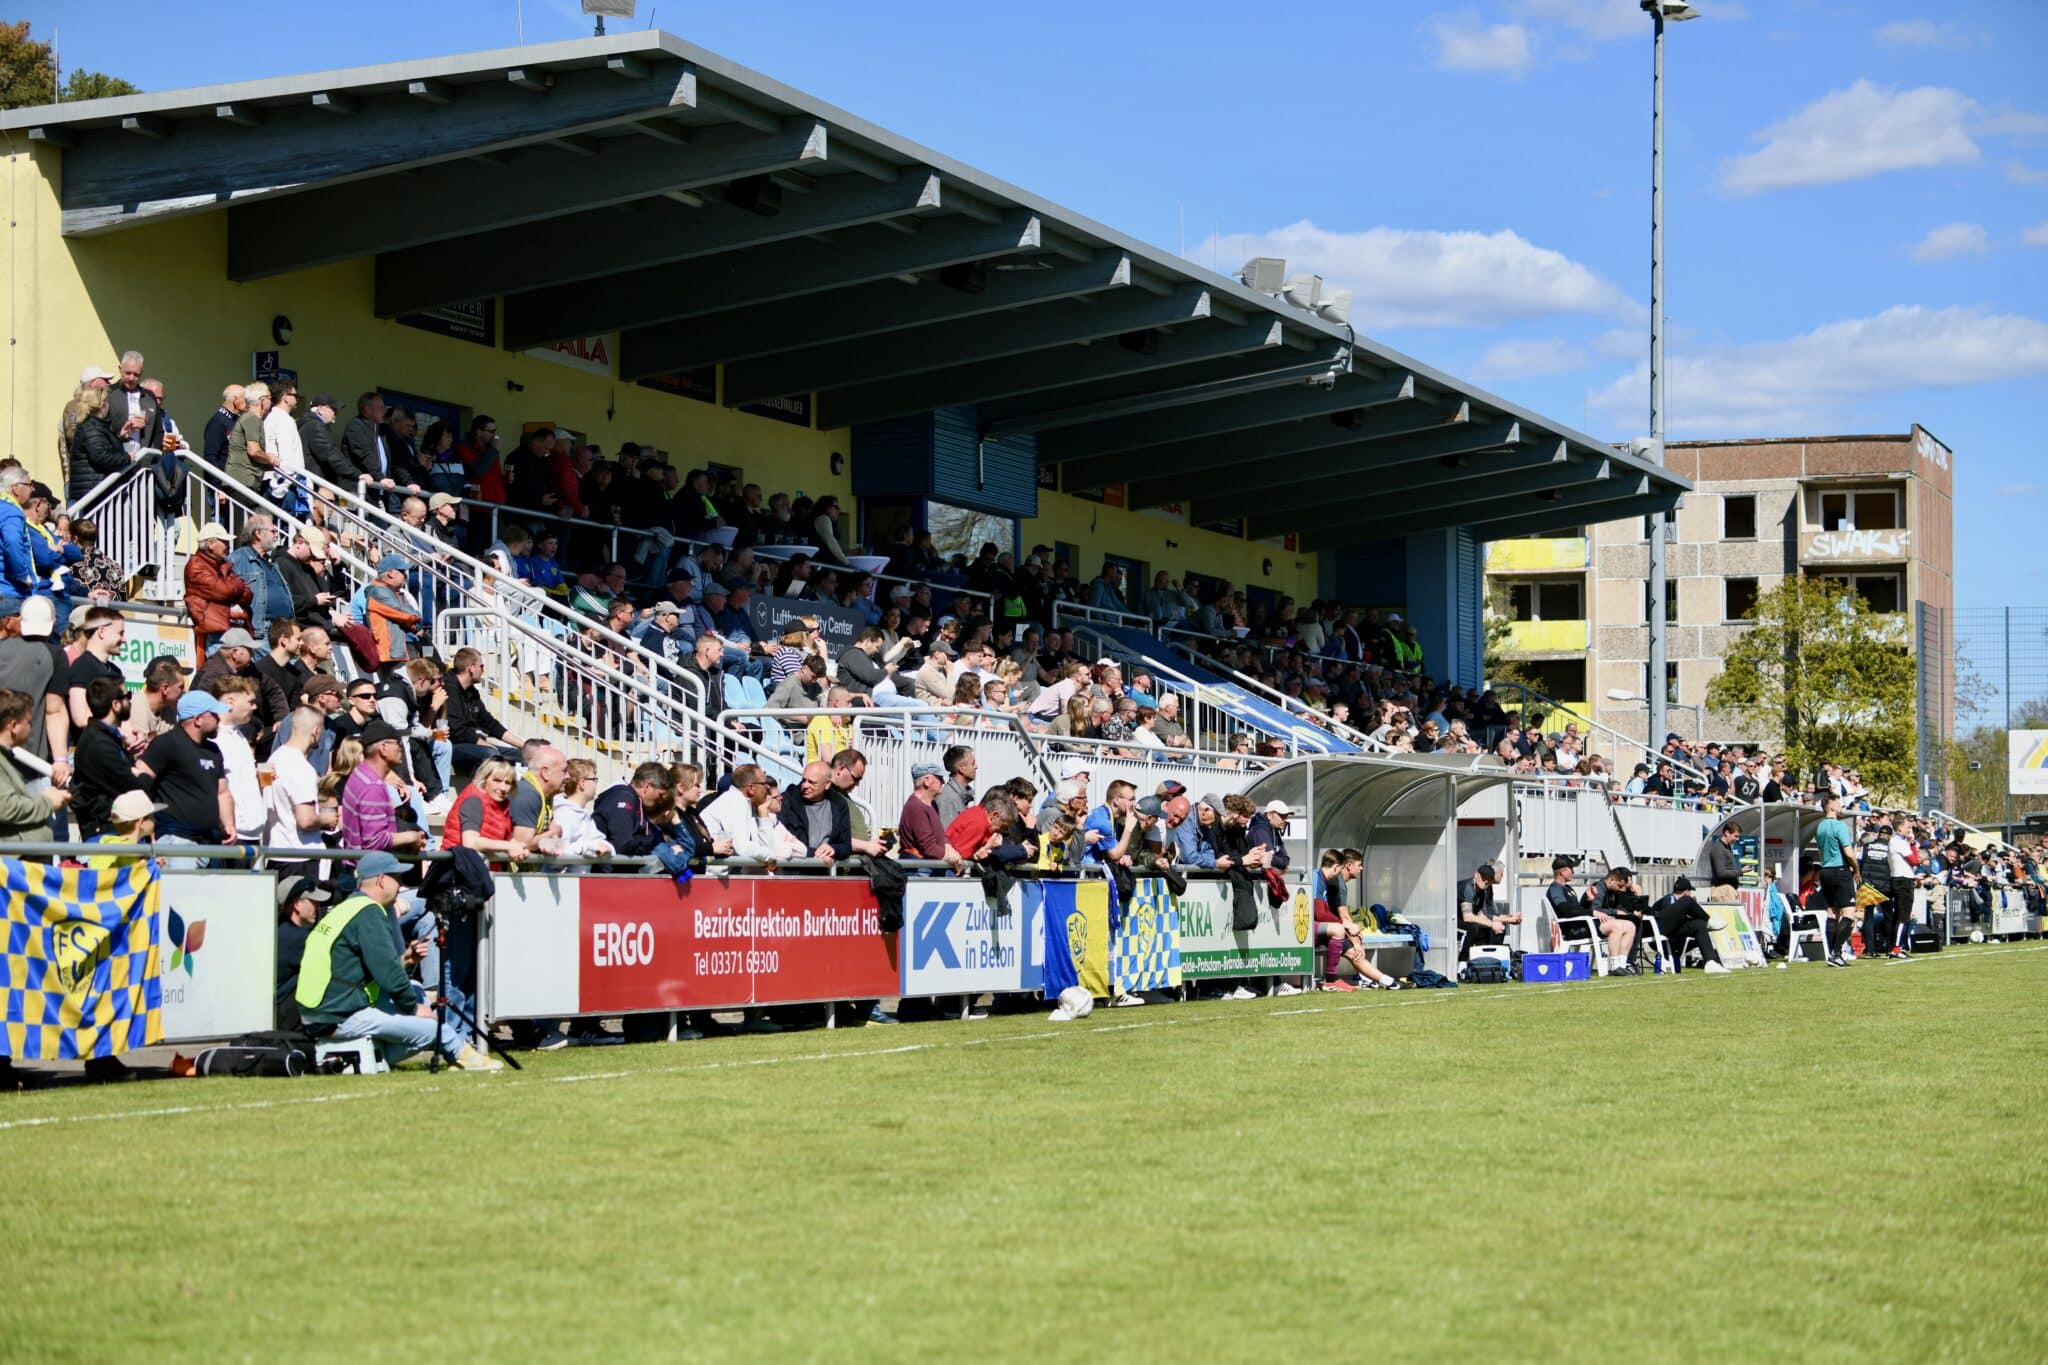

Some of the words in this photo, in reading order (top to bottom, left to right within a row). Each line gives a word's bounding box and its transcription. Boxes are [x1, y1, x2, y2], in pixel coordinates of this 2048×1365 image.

[828, 616, 854, 637] Center
[158, 642, 187, 658] GmbH
[1742, 781, 1757, 796] 67
[694, 907, 800, 939] Bezirksdirektion
[803, 908, 860, 937] Burkhard
[593, 921, 655, 967] ERGO
[965, 940, 977, 969] in
[980, 940, 1015, 969] Beton
[694, 952, 709, 976] Tel
[712, 951, 744, 975] 03371
[747, 949, 779, 975] 69300
